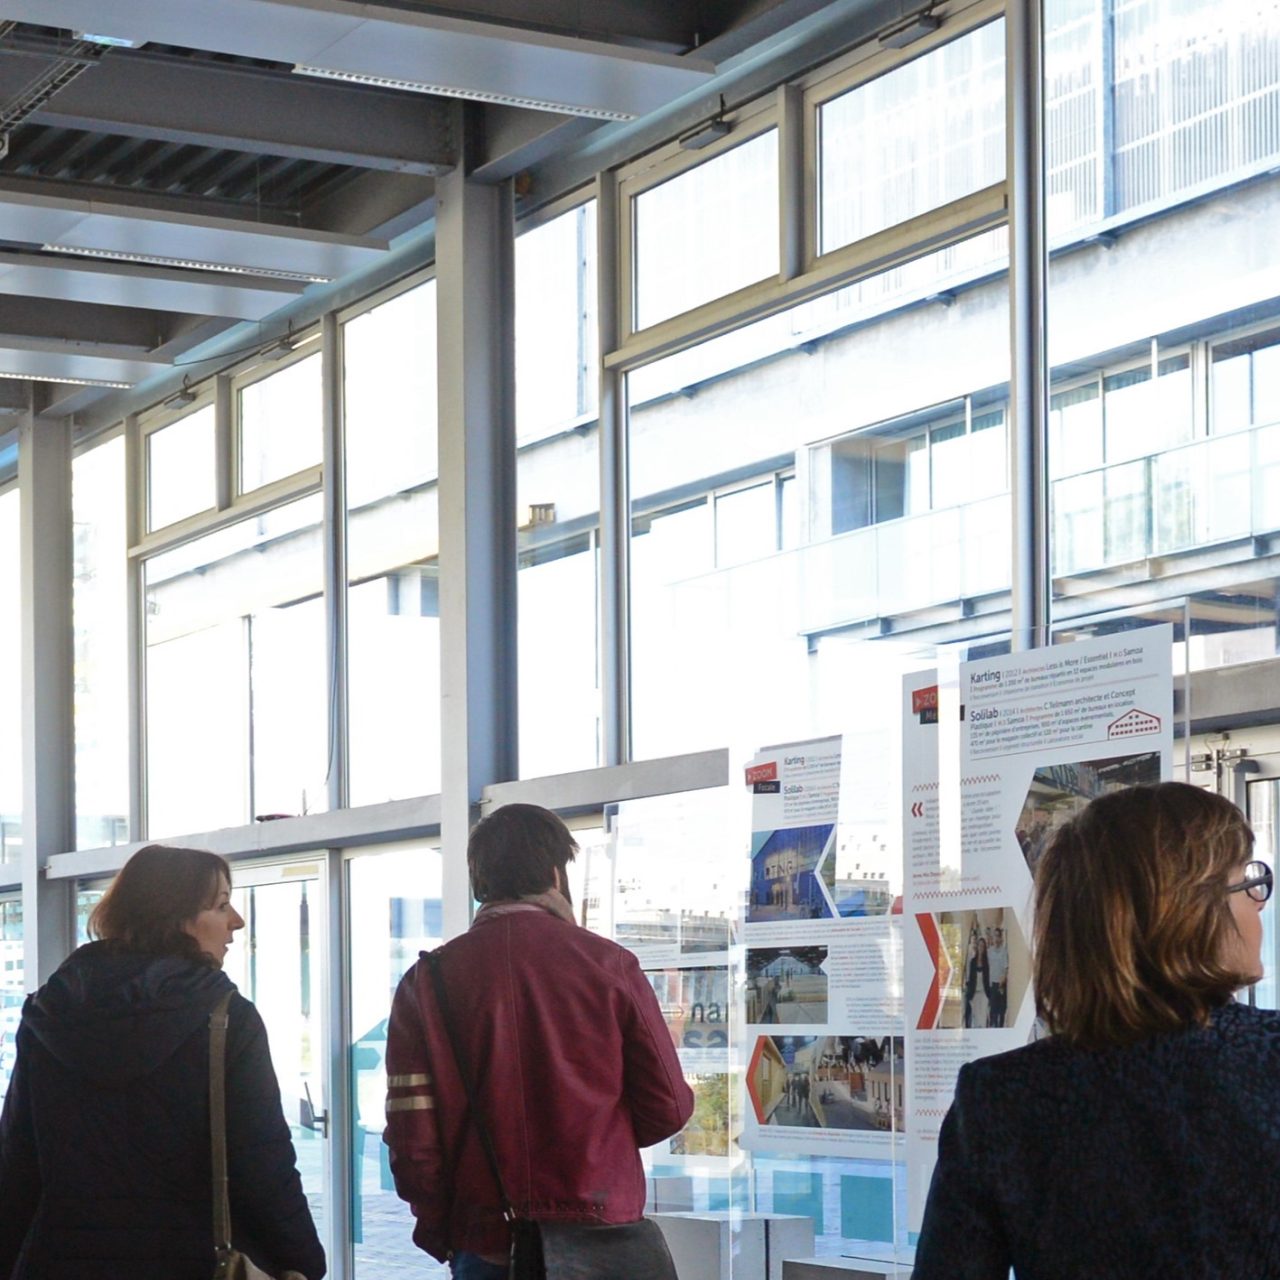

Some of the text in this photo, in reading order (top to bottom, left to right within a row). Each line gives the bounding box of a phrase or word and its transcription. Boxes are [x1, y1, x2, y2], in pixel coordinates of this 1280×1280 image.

[970, 669, 1001, 684] Karting
[970, 708, 998, 722] Solilab
[1111, 688, 1136, 699] Concept
[784, 756, 805, 766] Karting
